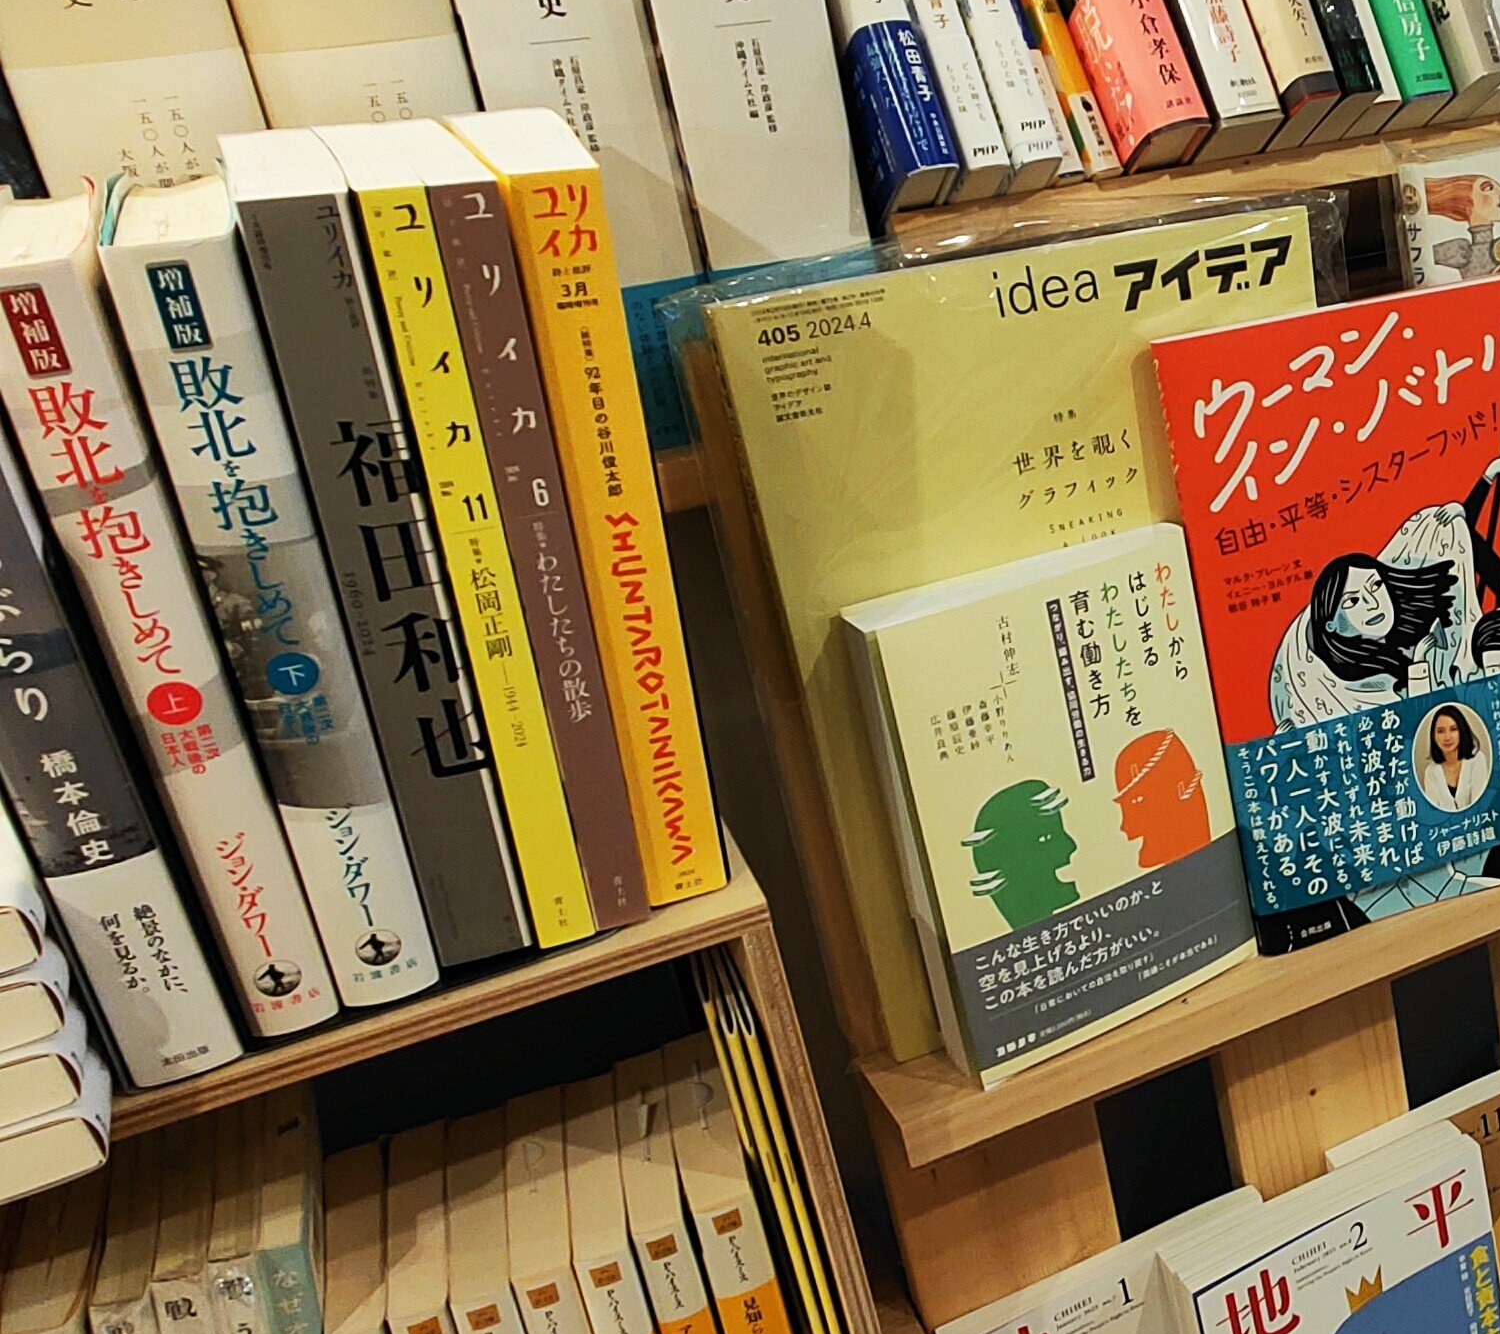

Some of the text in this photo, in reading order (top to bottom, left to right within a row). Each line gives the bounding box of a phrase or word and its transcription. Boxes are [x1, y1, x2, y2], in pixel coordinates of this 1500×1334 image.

[10, 289, 61, 371] 増補版
[156, 268, 203, 346] 増補版
[393, 203, 471, 448] ユリイカ
[461, 193, 537, 434] ユリイカ
[757, 311, 872, 347] 405 2024.4
[991, 235, 1293, 319] idea アイデア
[169, 357, 301, 645] 敗北を抱きしめて
[462, 495, 489, 524] 11
[532, 478, 551, 508] 6
[1013, 428, 1134, 477] 世界を覗く
[1017, 465, 1140, 511] グラフィック
[1215, 401, 1500, 557] 自由・平等・シスターフッド!
[28, 382, 181, 675] 敗北を抱きしめて
[331, 420, 488, 779] 福田和也
[470, 567, 513, 660] 松岡正剛
[536, 552, 593, 723] わたしたちの散歩
[1068, 590, 1111, 718] 育む働き方
[1100, 581, 1144, 727] わたしたちを
[1128, 571, 1160, 668] はじまる
[1155, 562, 1191, 682] わたしから
[39, 750, 115, 864] 橋本倫史
[1255, 736, 1304, 889] パワーがある。
[1279, 733, 1329, 897] 一人一人にその
[1379, 708, 1423, 868] あなたが動けば
[216, 832, 272, 958] ジョン・ダワー
[325, 804, 374, 927] ジョン・ダワー
[1349, 1221, 1369, 1251] 2
[1405, 1169, 1474, 1248] 平
